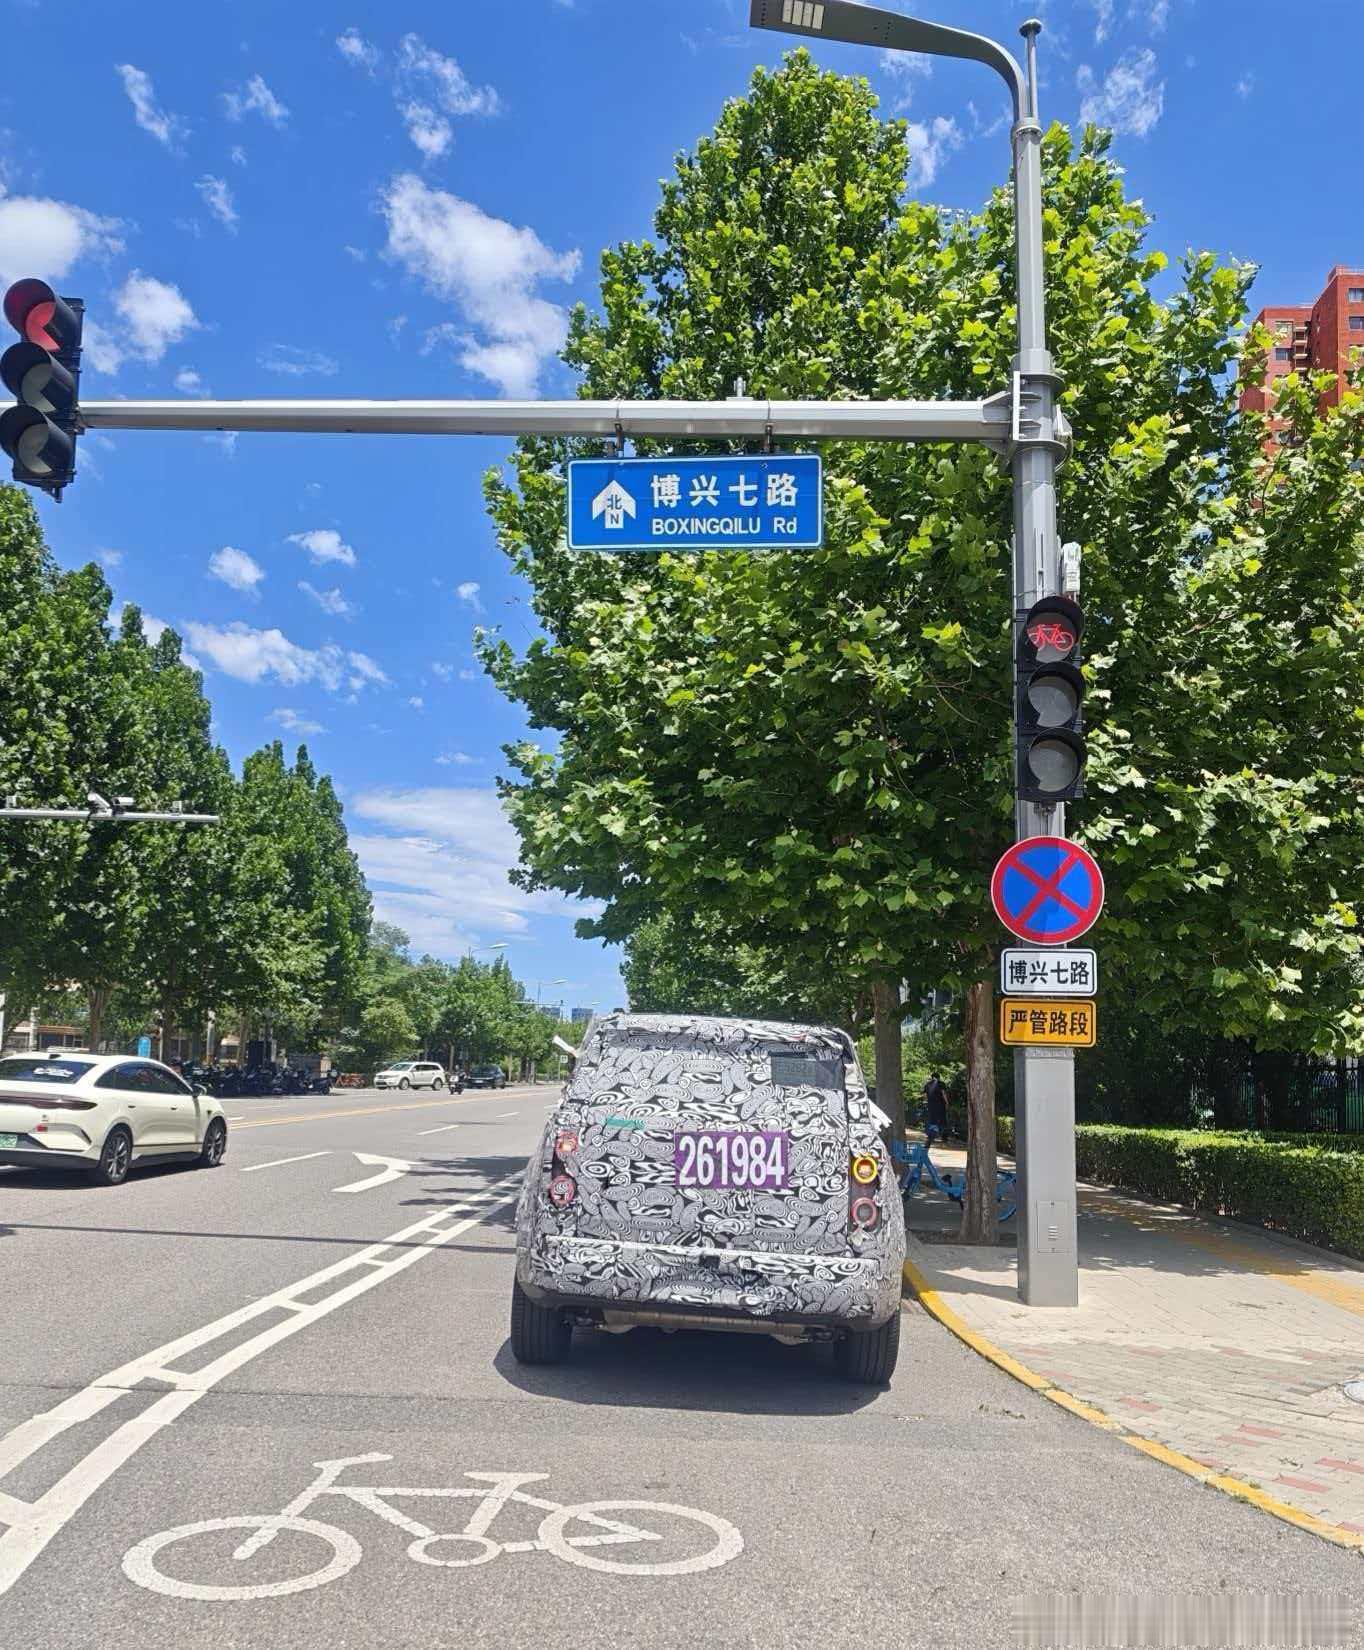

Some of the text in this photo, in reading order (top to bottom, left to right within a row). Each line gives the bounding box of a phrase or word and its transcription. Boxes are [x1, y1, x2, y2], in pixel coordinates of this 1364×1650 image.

[607, 494, 623, 510] 北
[651, 473, 799, 508] 博兴七路
[610, 513, 620, 525] N
[652, 517, 797, 536] BOXINGQILU Rd
[1008, 960, 1090, 985] 博兴七路
[1008, 1009, 1089, 1036] 严管路段
[679, 1135, 785, 1186] 261984
